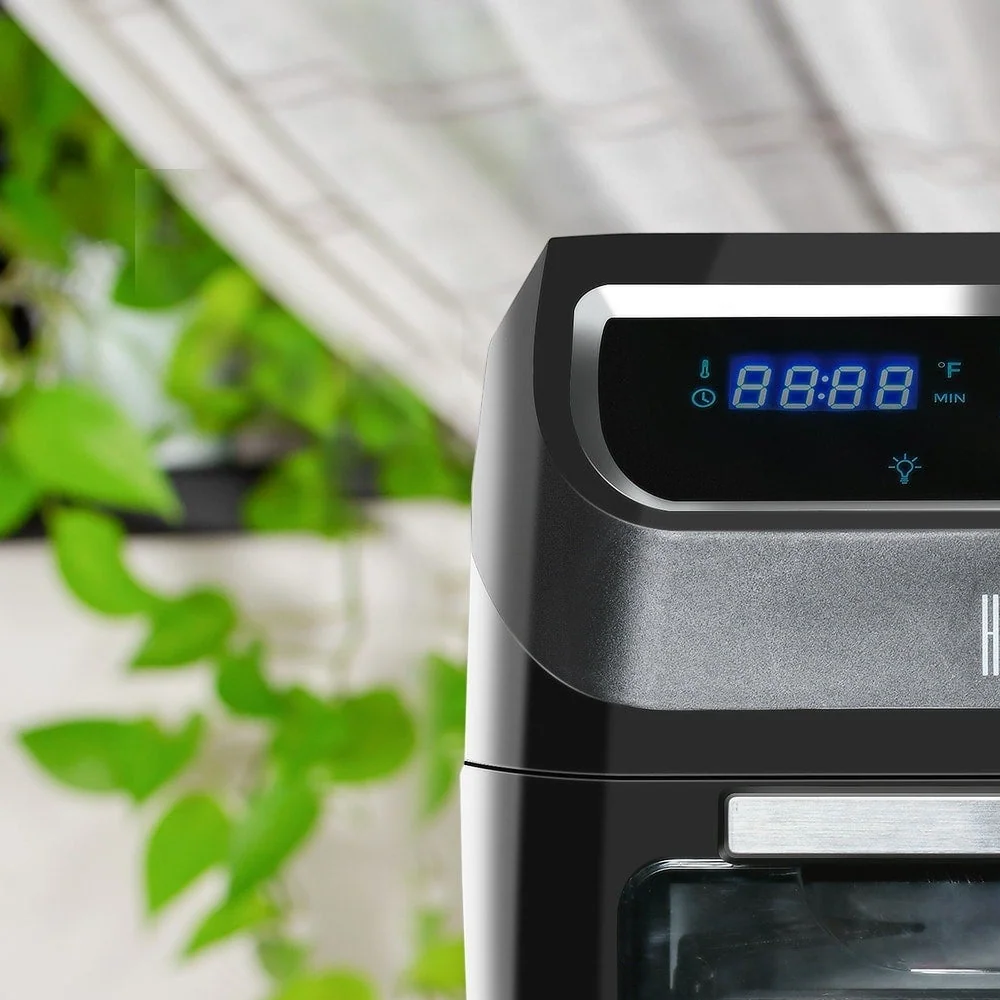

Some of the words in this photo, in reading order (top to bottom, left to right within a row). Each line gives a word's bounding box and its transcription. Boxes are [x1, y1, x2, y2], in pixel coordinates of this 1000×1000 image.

[937, 361, 962, 379] °F
[732, 365, 914, 410] 88:88
[933, 393, 966, 404] MIN
